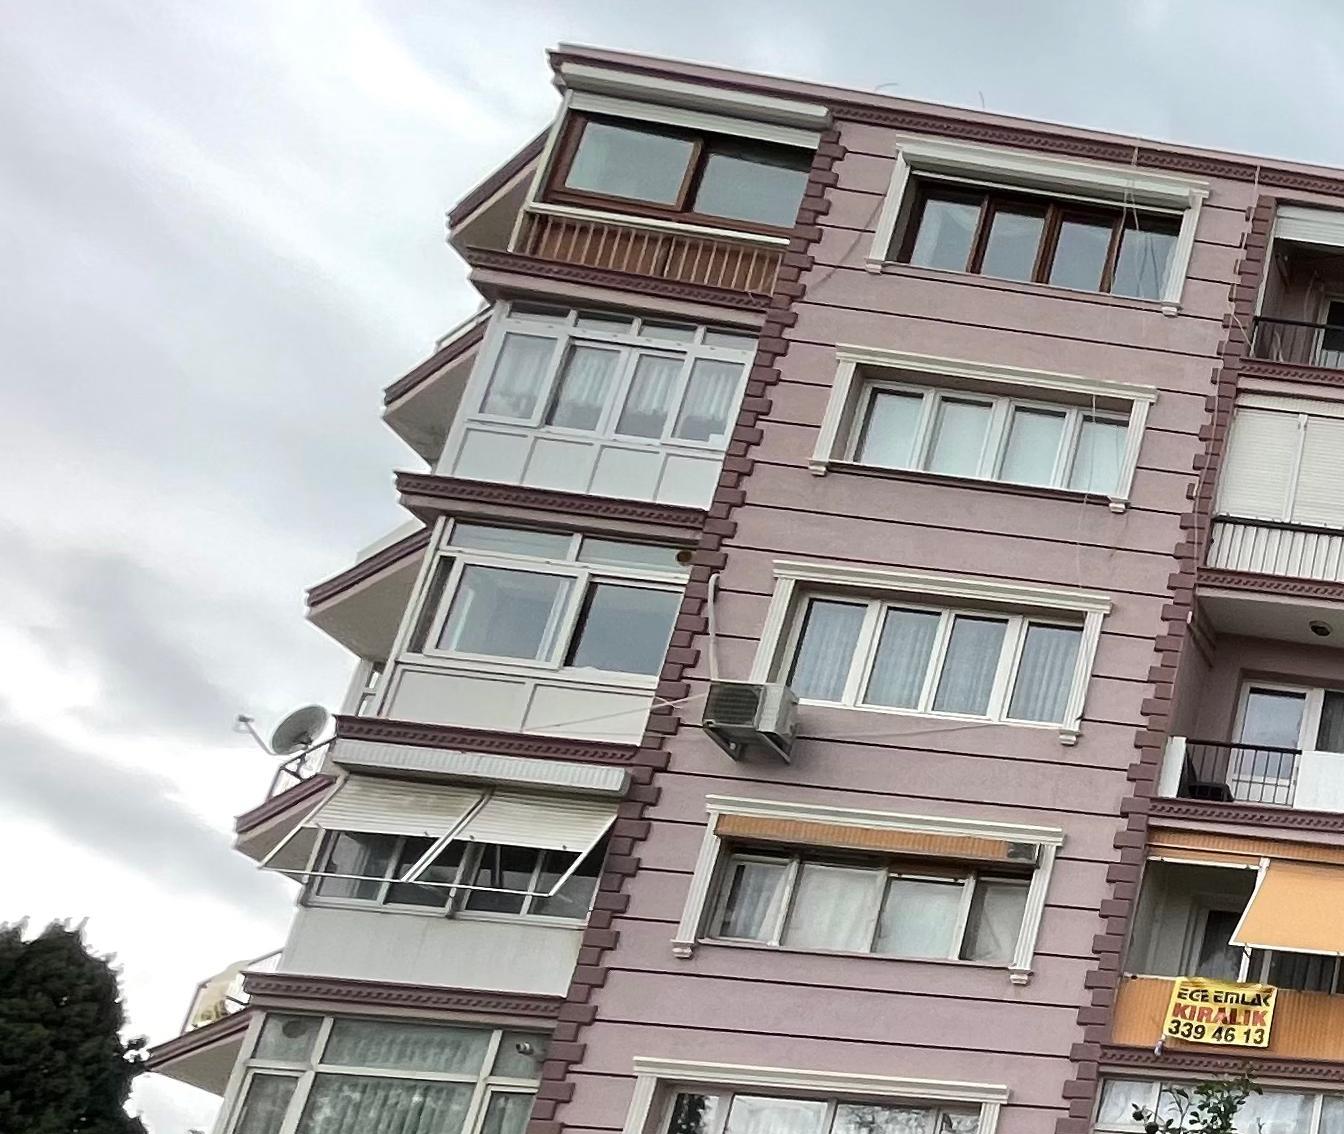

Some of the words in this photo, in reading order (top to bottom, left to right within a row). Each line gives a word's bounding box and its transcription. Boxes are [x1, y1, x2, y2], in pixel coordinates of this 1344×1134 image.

[1177, 987, 1210, 1003] EGE
[1212, 990, 1272, 1007] EMLAK
[1172, 1002, 1268, 1027] KIRALIK
[1167, 1019, 1206, 1040] 339
[1211, 1025, 1236, 1042] 46
[1243, 1028, 1265, 1045] 13
